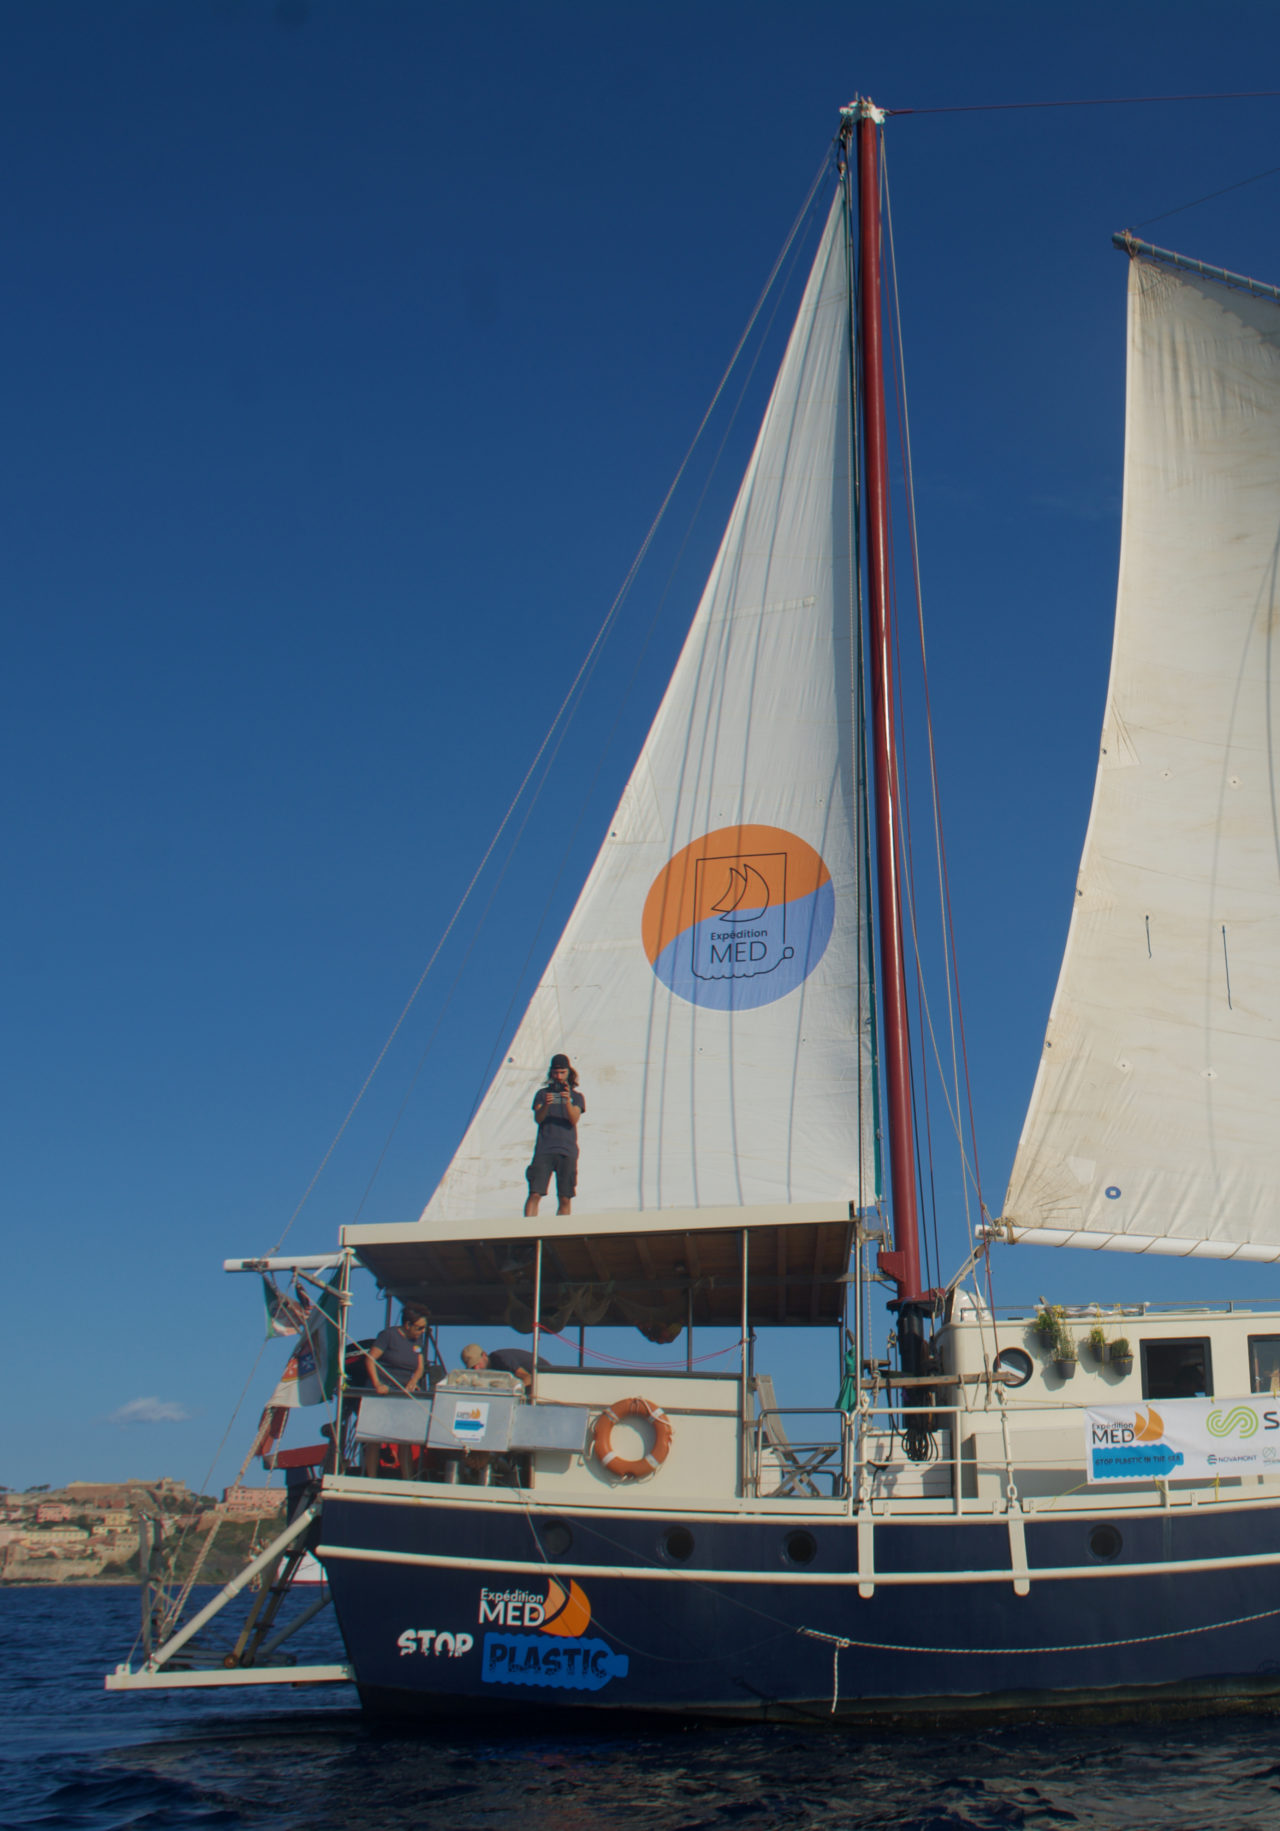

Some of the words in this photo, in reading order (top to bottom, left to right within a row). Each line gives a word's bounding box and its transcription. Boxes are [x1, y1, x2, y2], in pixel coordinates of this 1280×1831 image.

[710, 941, 768, 964] MED
[1092, 1428, 1135, 1445] MED
[480, 1587, 544, 1604] Expédition
[478, 1600, 546, 1627] MED
[397, 1628, 474, 1658] STOP
[488, 1642, 609, 1679] PLASTIC
